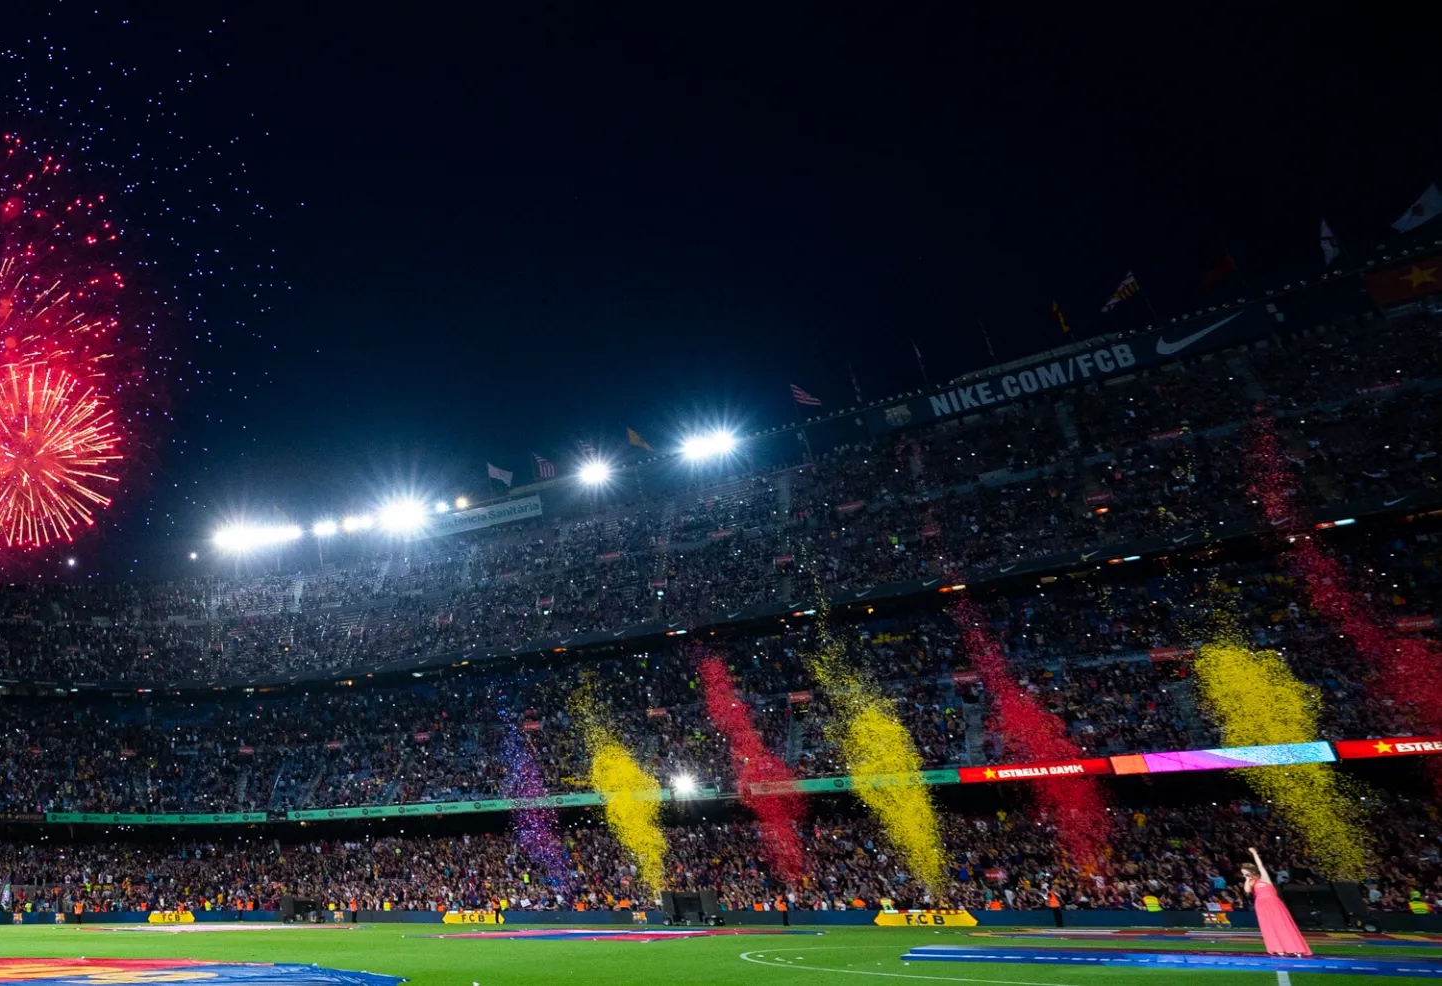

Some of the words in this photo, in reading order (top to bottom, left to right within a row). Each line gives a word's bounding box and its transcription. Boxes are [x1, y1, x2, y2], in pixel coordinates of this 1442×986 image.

[928, 344, 1137, 417] NIKE.COM/FCB
[998, 767, 1048, 778] ESTRELLA
[1050, 765, 1084, 775] DAMM
[162, 914, 181, 922] FCB
[461, 914, 486, 923] FCB
[905, 914, 946, 925] FCB
